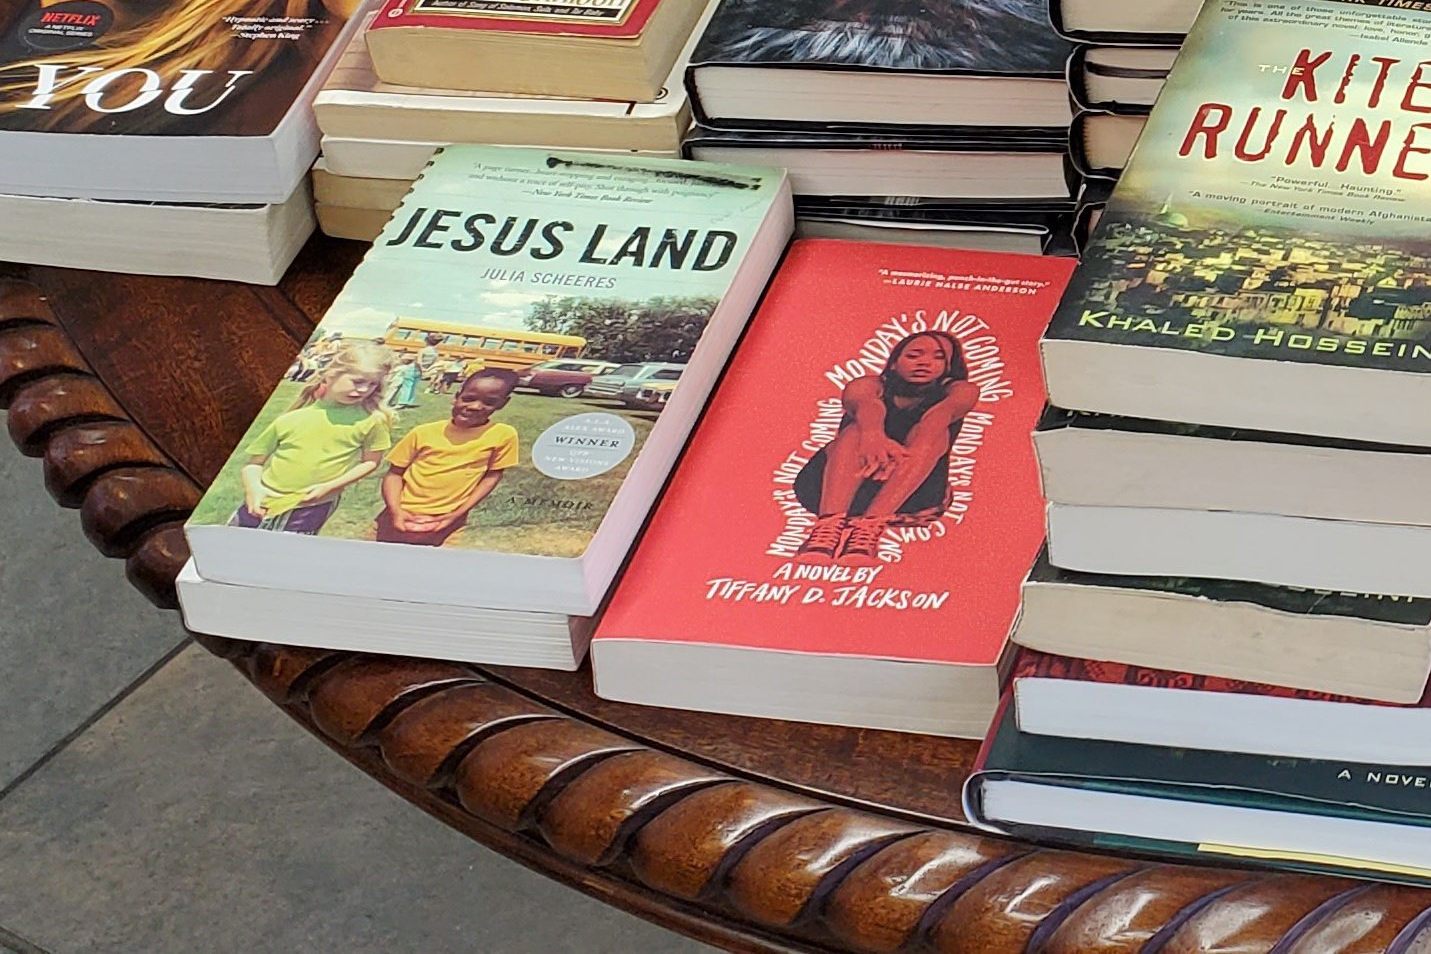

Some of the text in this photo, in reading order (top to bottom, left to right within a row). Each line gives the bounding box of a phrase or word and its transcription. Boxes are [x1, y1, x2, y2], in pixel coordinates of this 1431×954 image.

[40, 13, 99, 26] NETFLIX
[1259, 64, 1304, 76] THE
[15, 64, 252, 116] YOU
[387, 208, 738, 272] JESUS LAND
[481, 268, 617, 289] JULIA SCHEERES
[1078, 309, 1235, 344] KHALED
[554, 435, 620, 449] WINNER
[706, 577, 950, 609] TIFFANY D. JACKSON
